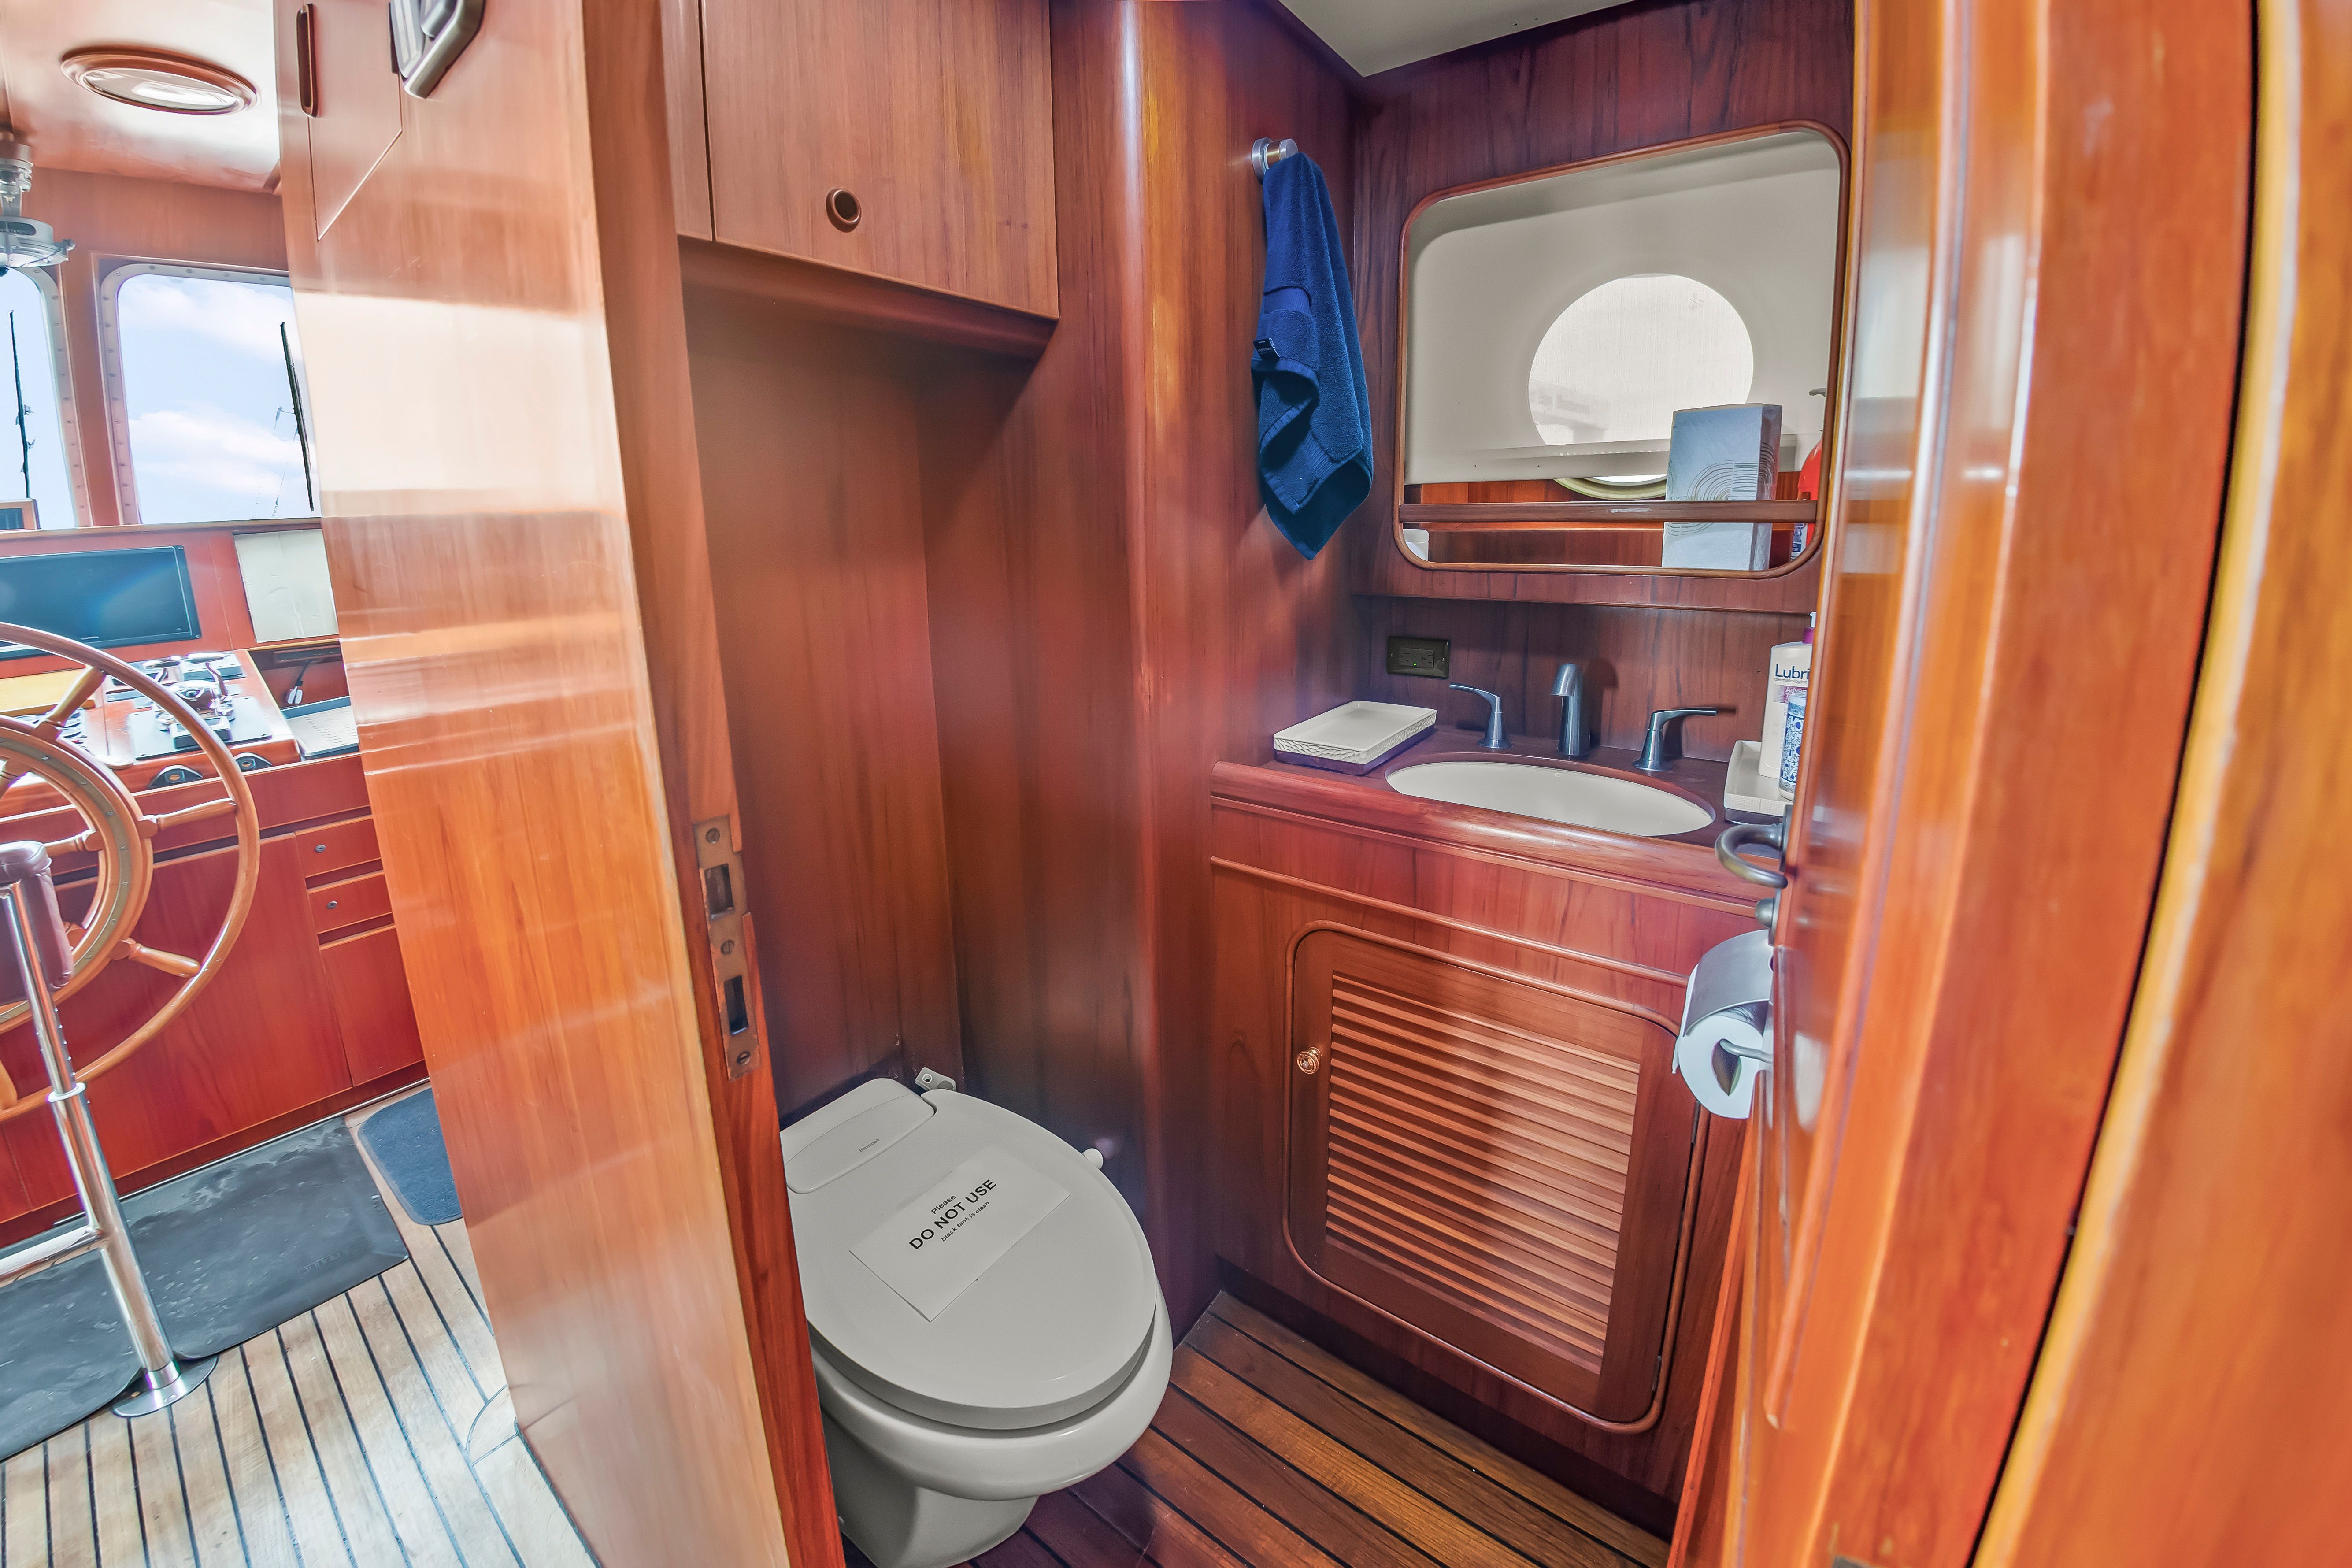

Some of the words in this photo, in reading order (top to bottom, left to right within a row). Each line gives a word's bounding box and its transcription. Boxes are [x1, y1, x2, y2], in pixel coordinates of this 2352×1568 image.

[1775, 664, 1810, 680] Lubri
[908, 1229, 934, 1249] DO
[933, 1201, 966, 1229] NOT
[965, 1179, 997, 1203] USE
[931, 1195, 956, 1214] Please
[941, 1227, 957, 1242] black
[957, 1217, 970, 1227] tank
[975, 1201, 990, 1214] clean
